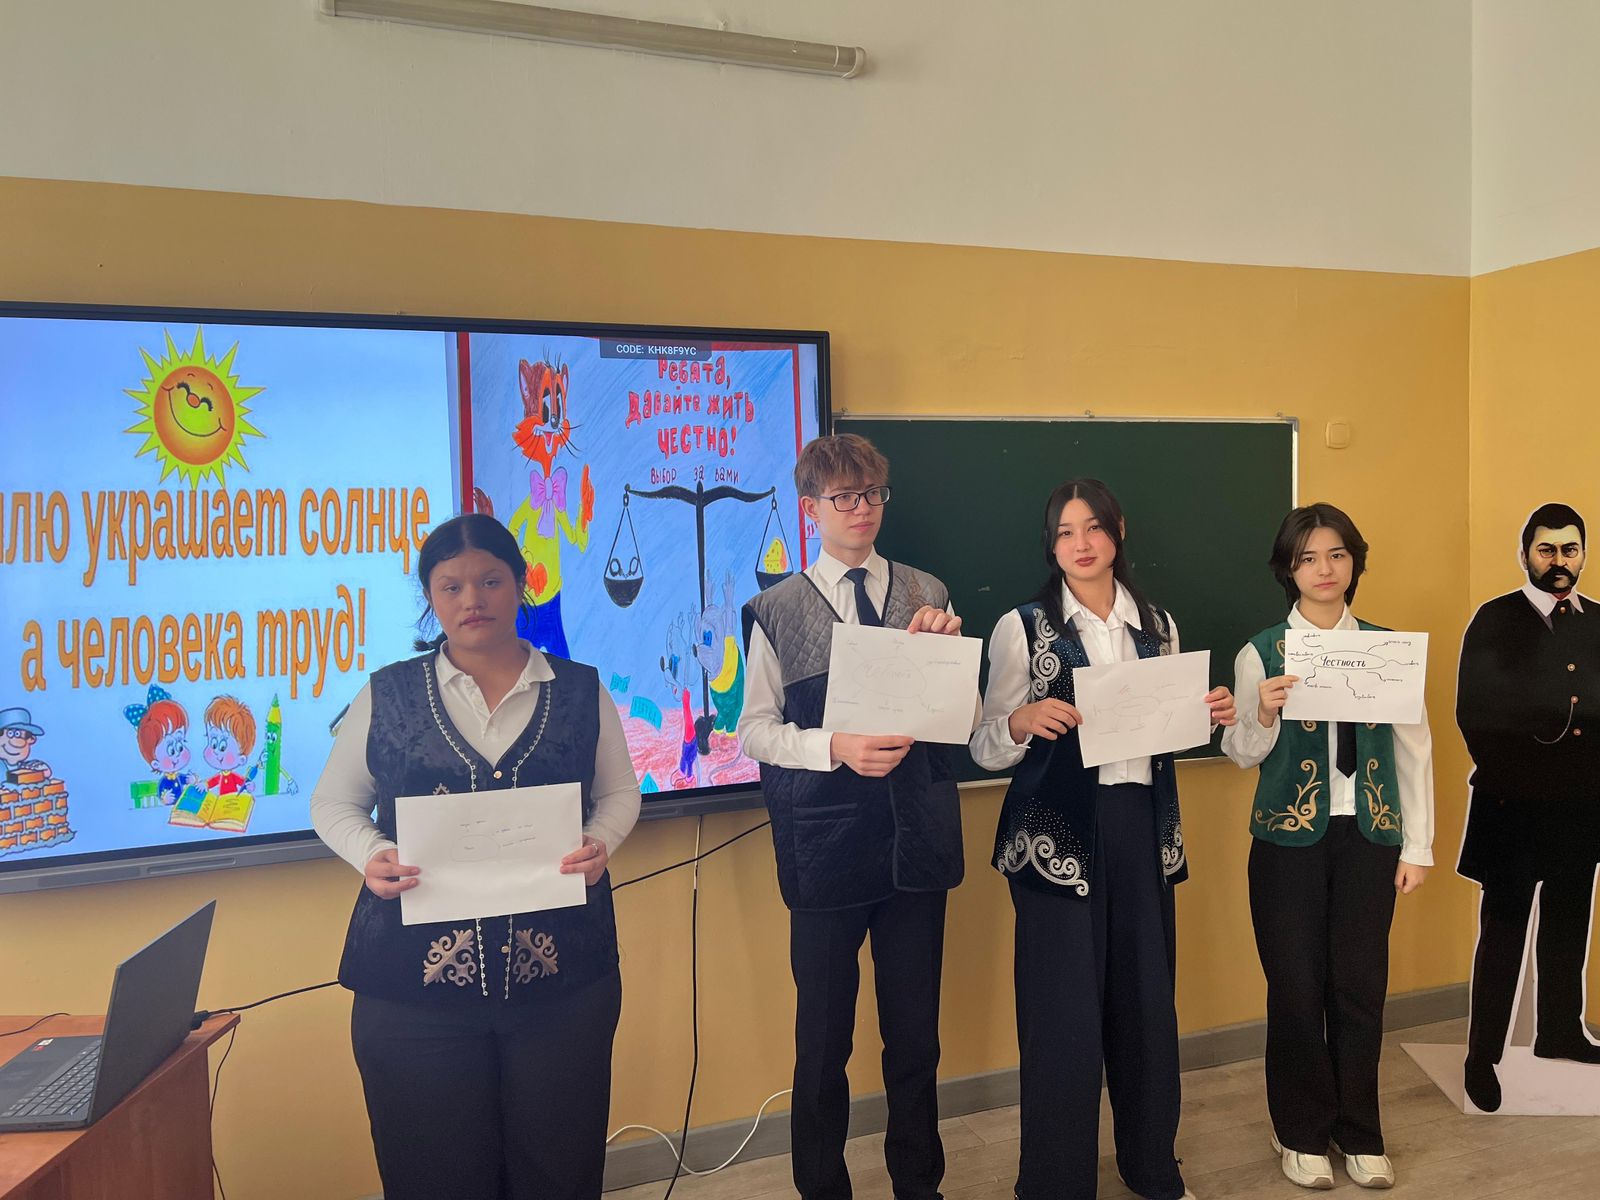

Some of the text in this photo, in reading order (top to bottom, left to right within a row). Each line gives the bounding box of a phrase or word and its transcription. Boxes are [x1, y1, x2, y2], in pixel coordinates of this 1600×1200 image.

[616, 344, 697, 356] CODE: KHK8F9YC
[657, 424, 737, 460] ЧЕСТНО!
[82, 487, 287, 587] украшает
[300, 486, 430, 573] солнце
[20, 584, 366, 699] а человека труд!
[1320, 655, 1366, 667] Честность
